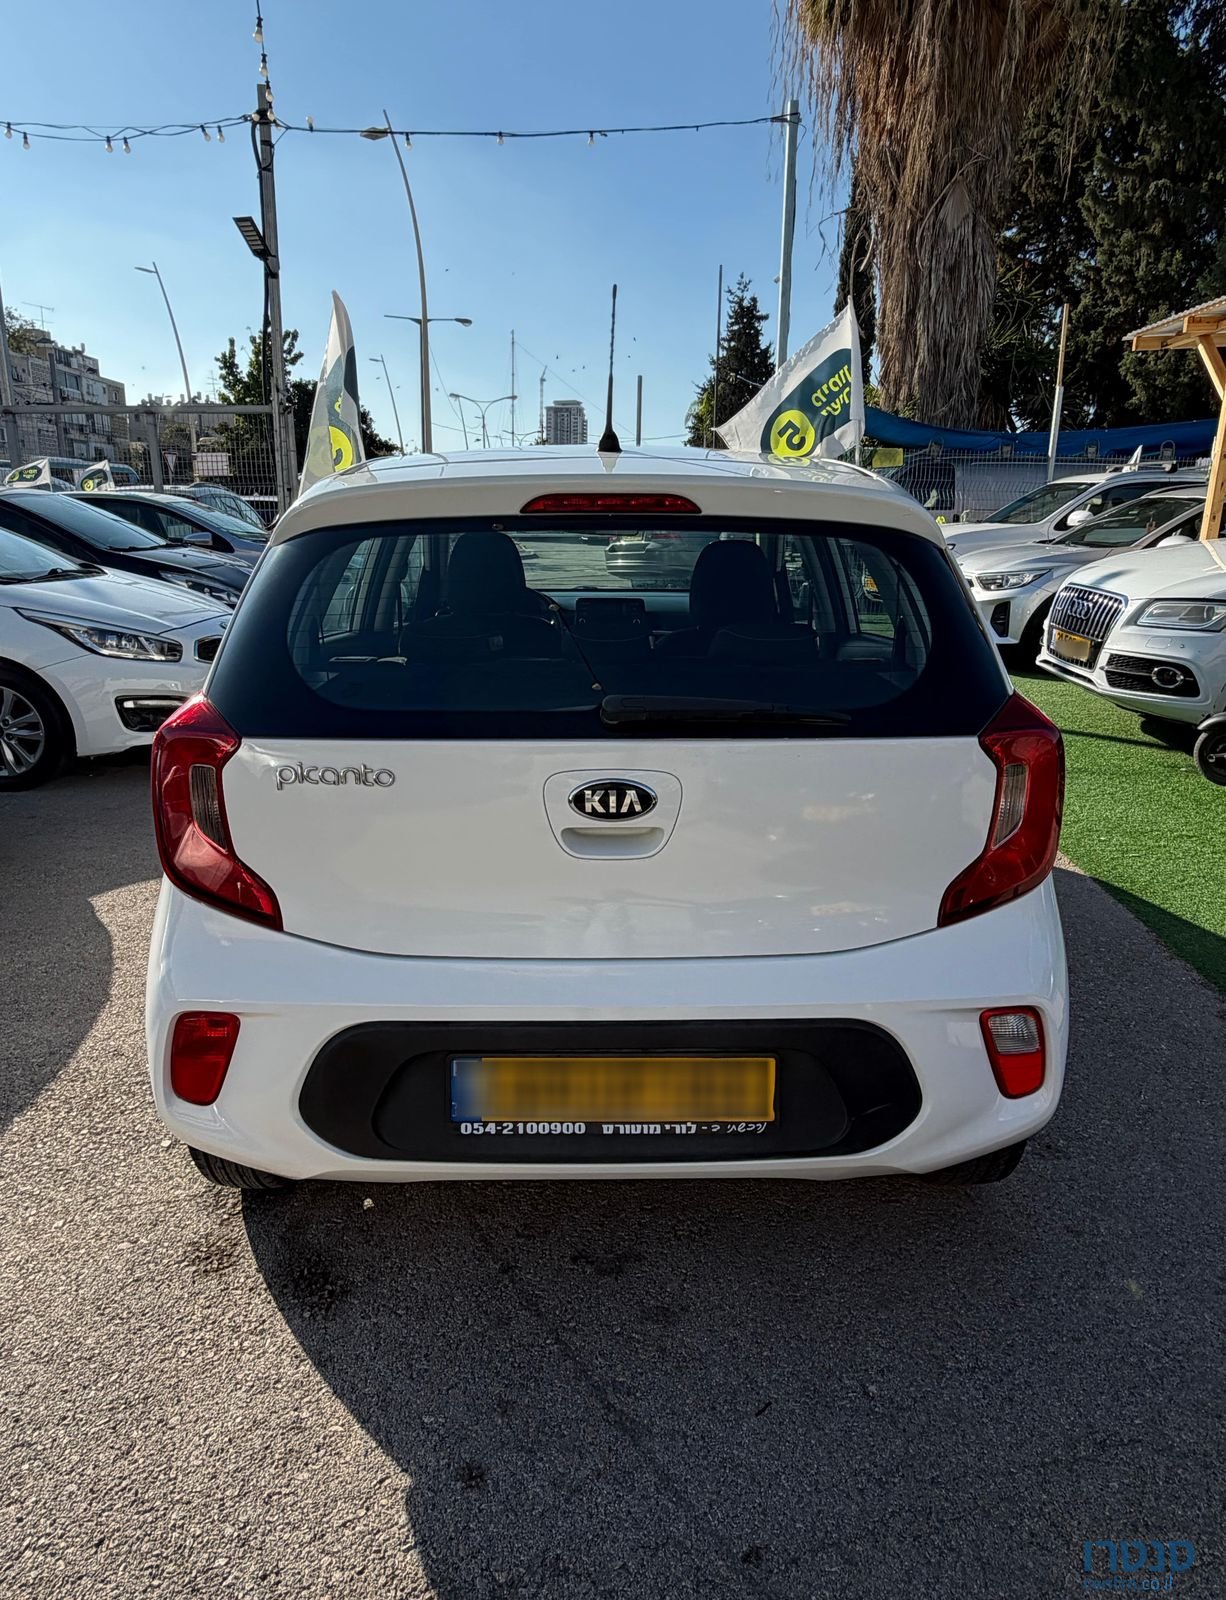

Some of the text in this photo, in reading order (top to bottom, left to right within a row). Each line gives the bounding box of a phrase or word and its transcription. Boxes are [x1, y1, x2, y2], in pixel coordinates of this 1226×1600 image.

[276, 762, 396, 791] picanto
[583, 789, 643, 813] KIA
[460, 1122, 586, 1135] 054-2100900
[601, 1123, 661, 1135] מוטורס
[664, 1121, 697, 1135] לורי
